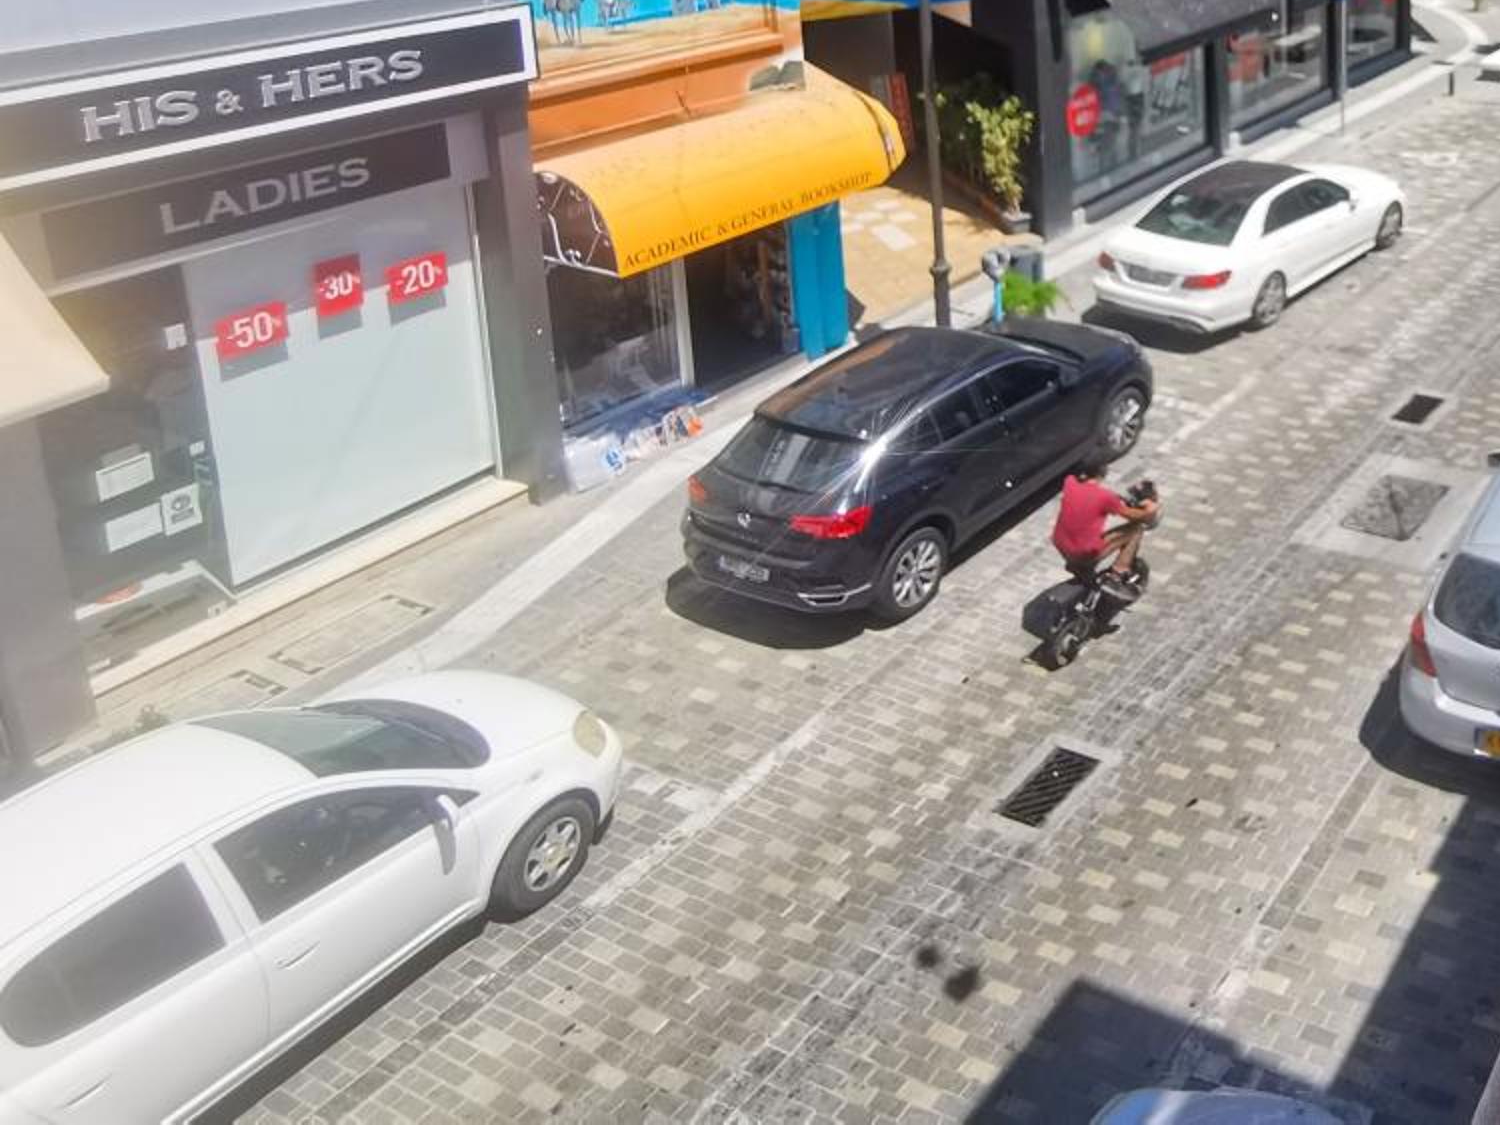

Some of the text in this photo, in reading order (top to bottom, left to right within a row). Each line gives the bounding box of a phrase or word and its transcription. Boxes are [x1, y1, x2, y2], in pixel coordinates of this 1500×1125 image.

[79, 49, 425, 143] HIS & HERS
[159, 156, 371, 236] LADIES
[623, 225, 710, 269] ACADEMIC
[731, 198, 796, 230] GENERAL
